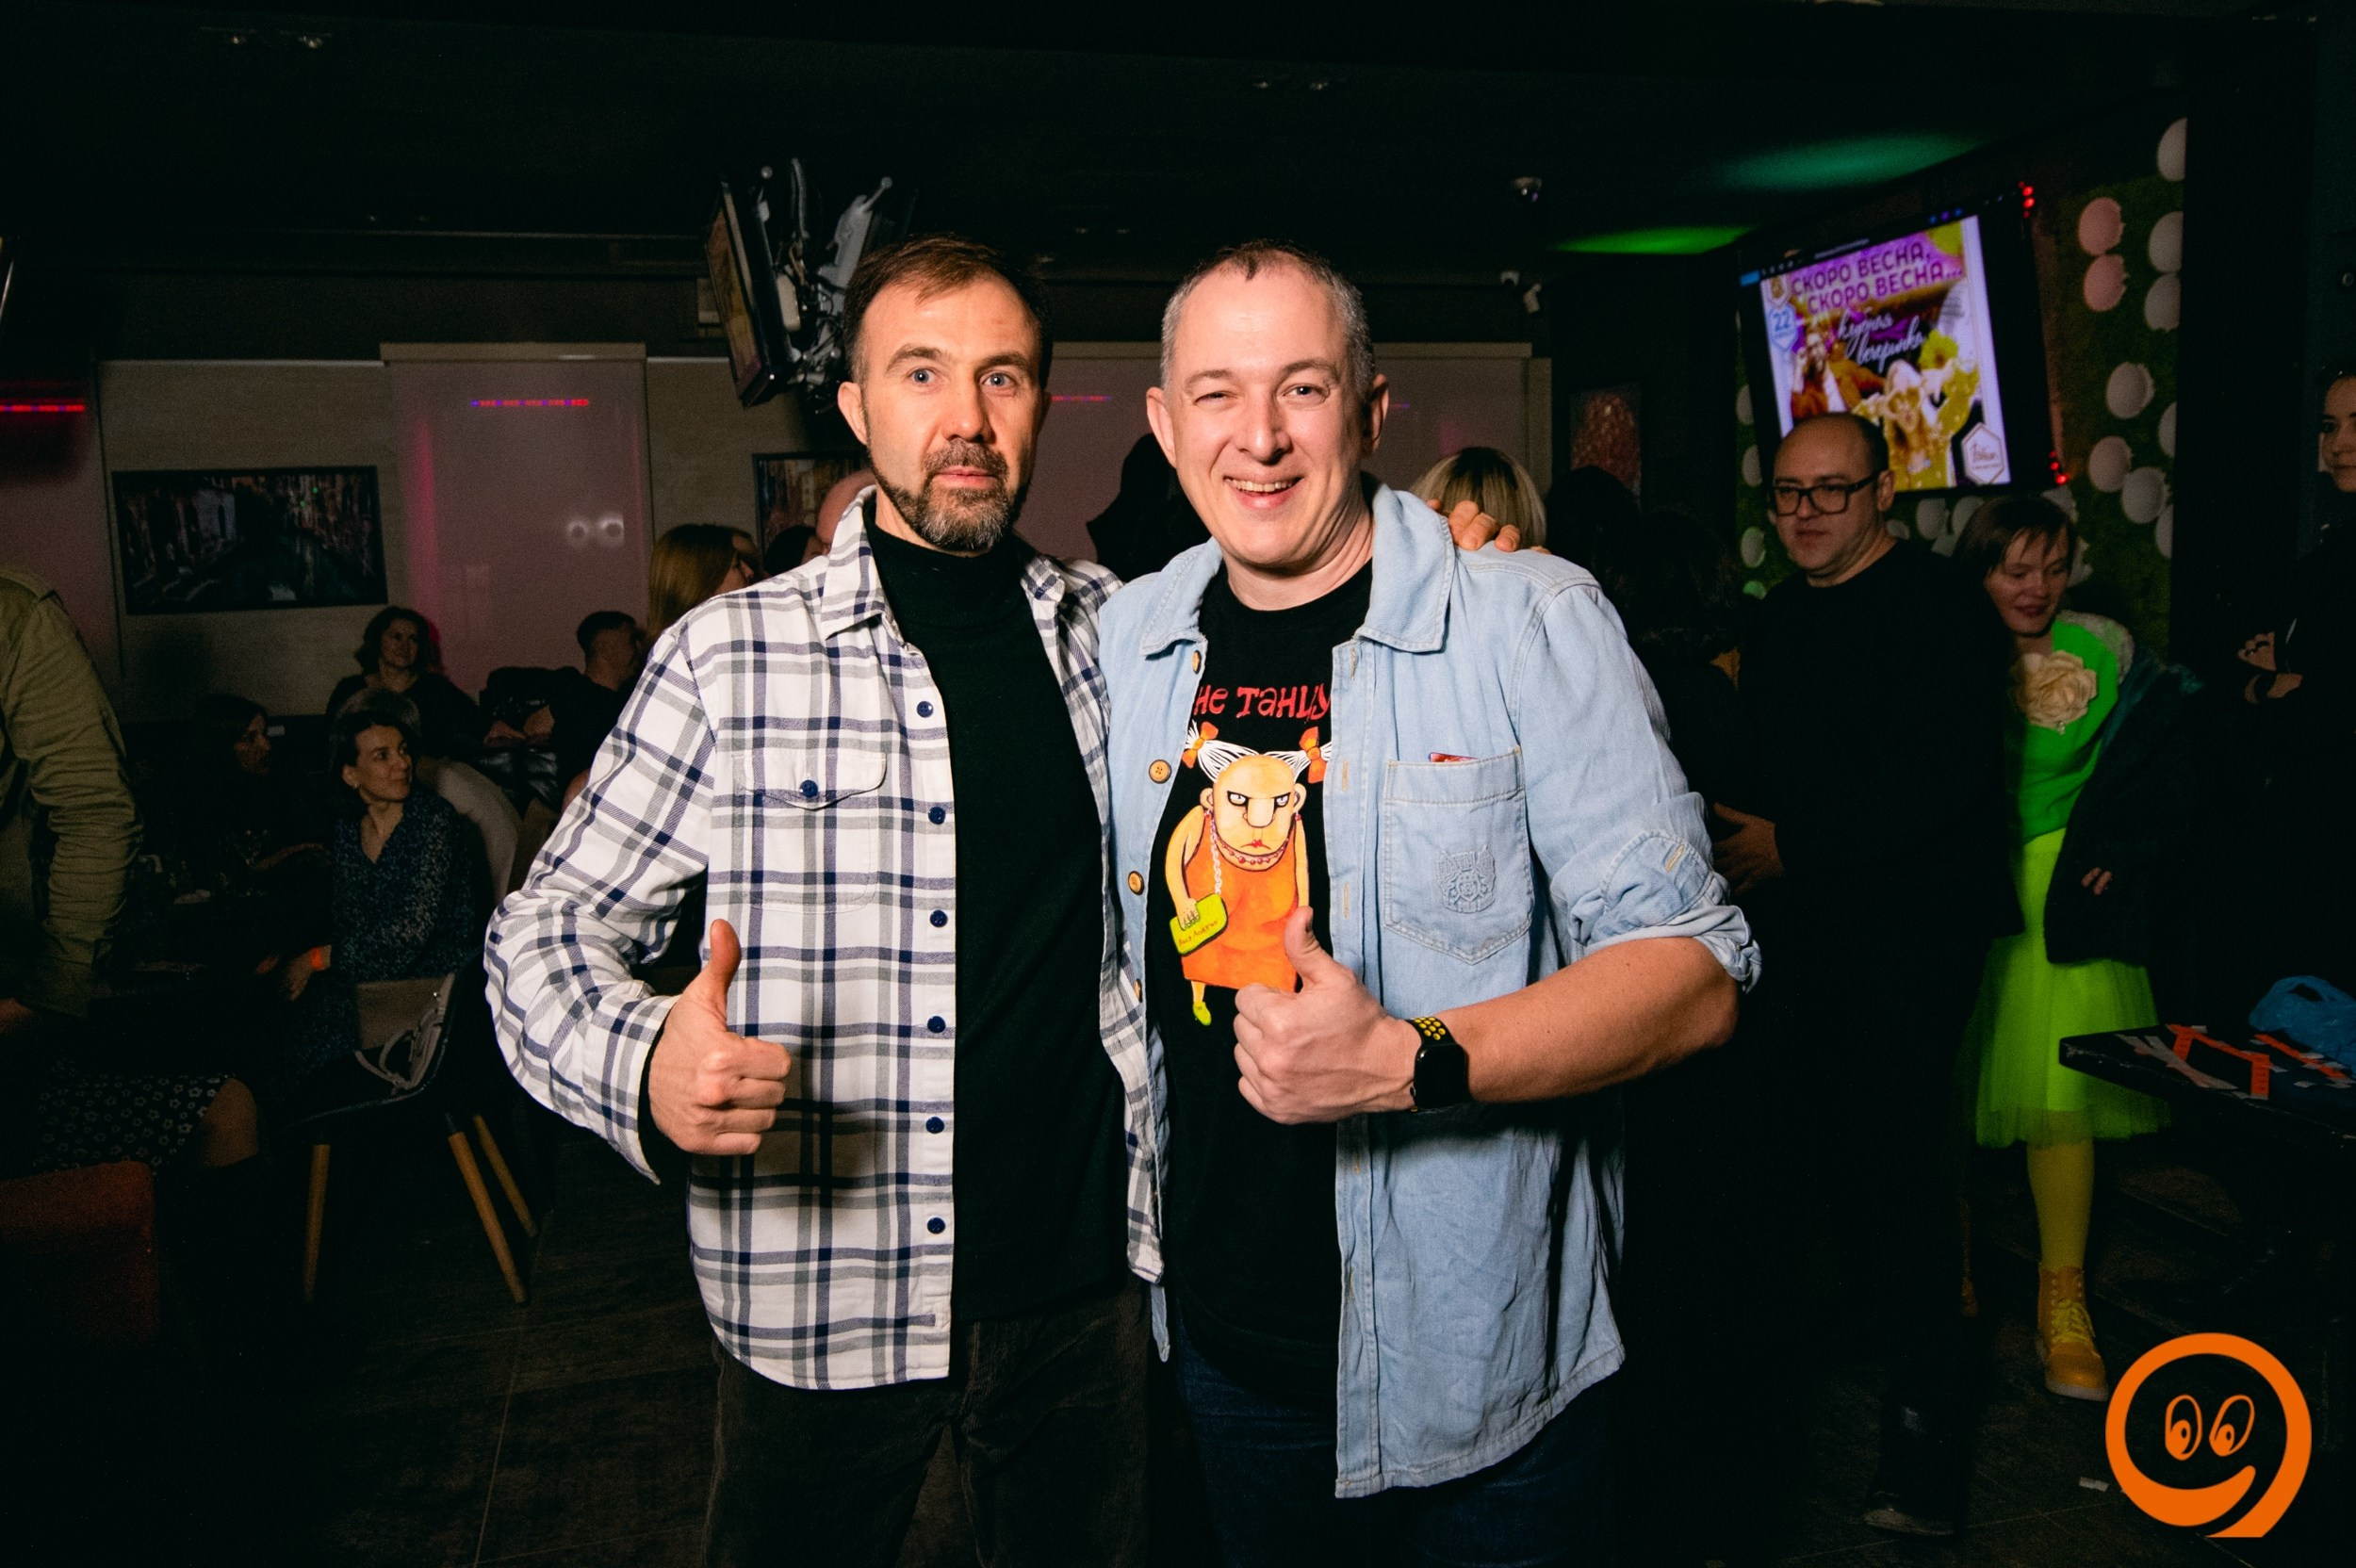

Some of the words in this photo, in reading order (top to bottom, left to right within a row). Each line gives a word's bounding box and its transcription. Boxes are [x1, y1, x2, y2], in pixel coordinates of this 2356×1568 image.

[1792, 265, 1851, 296] СКОРО
[1858, 242, 1931, 278] ВЕСНА,
[1808, 283, 1870, 315] СКОРО
